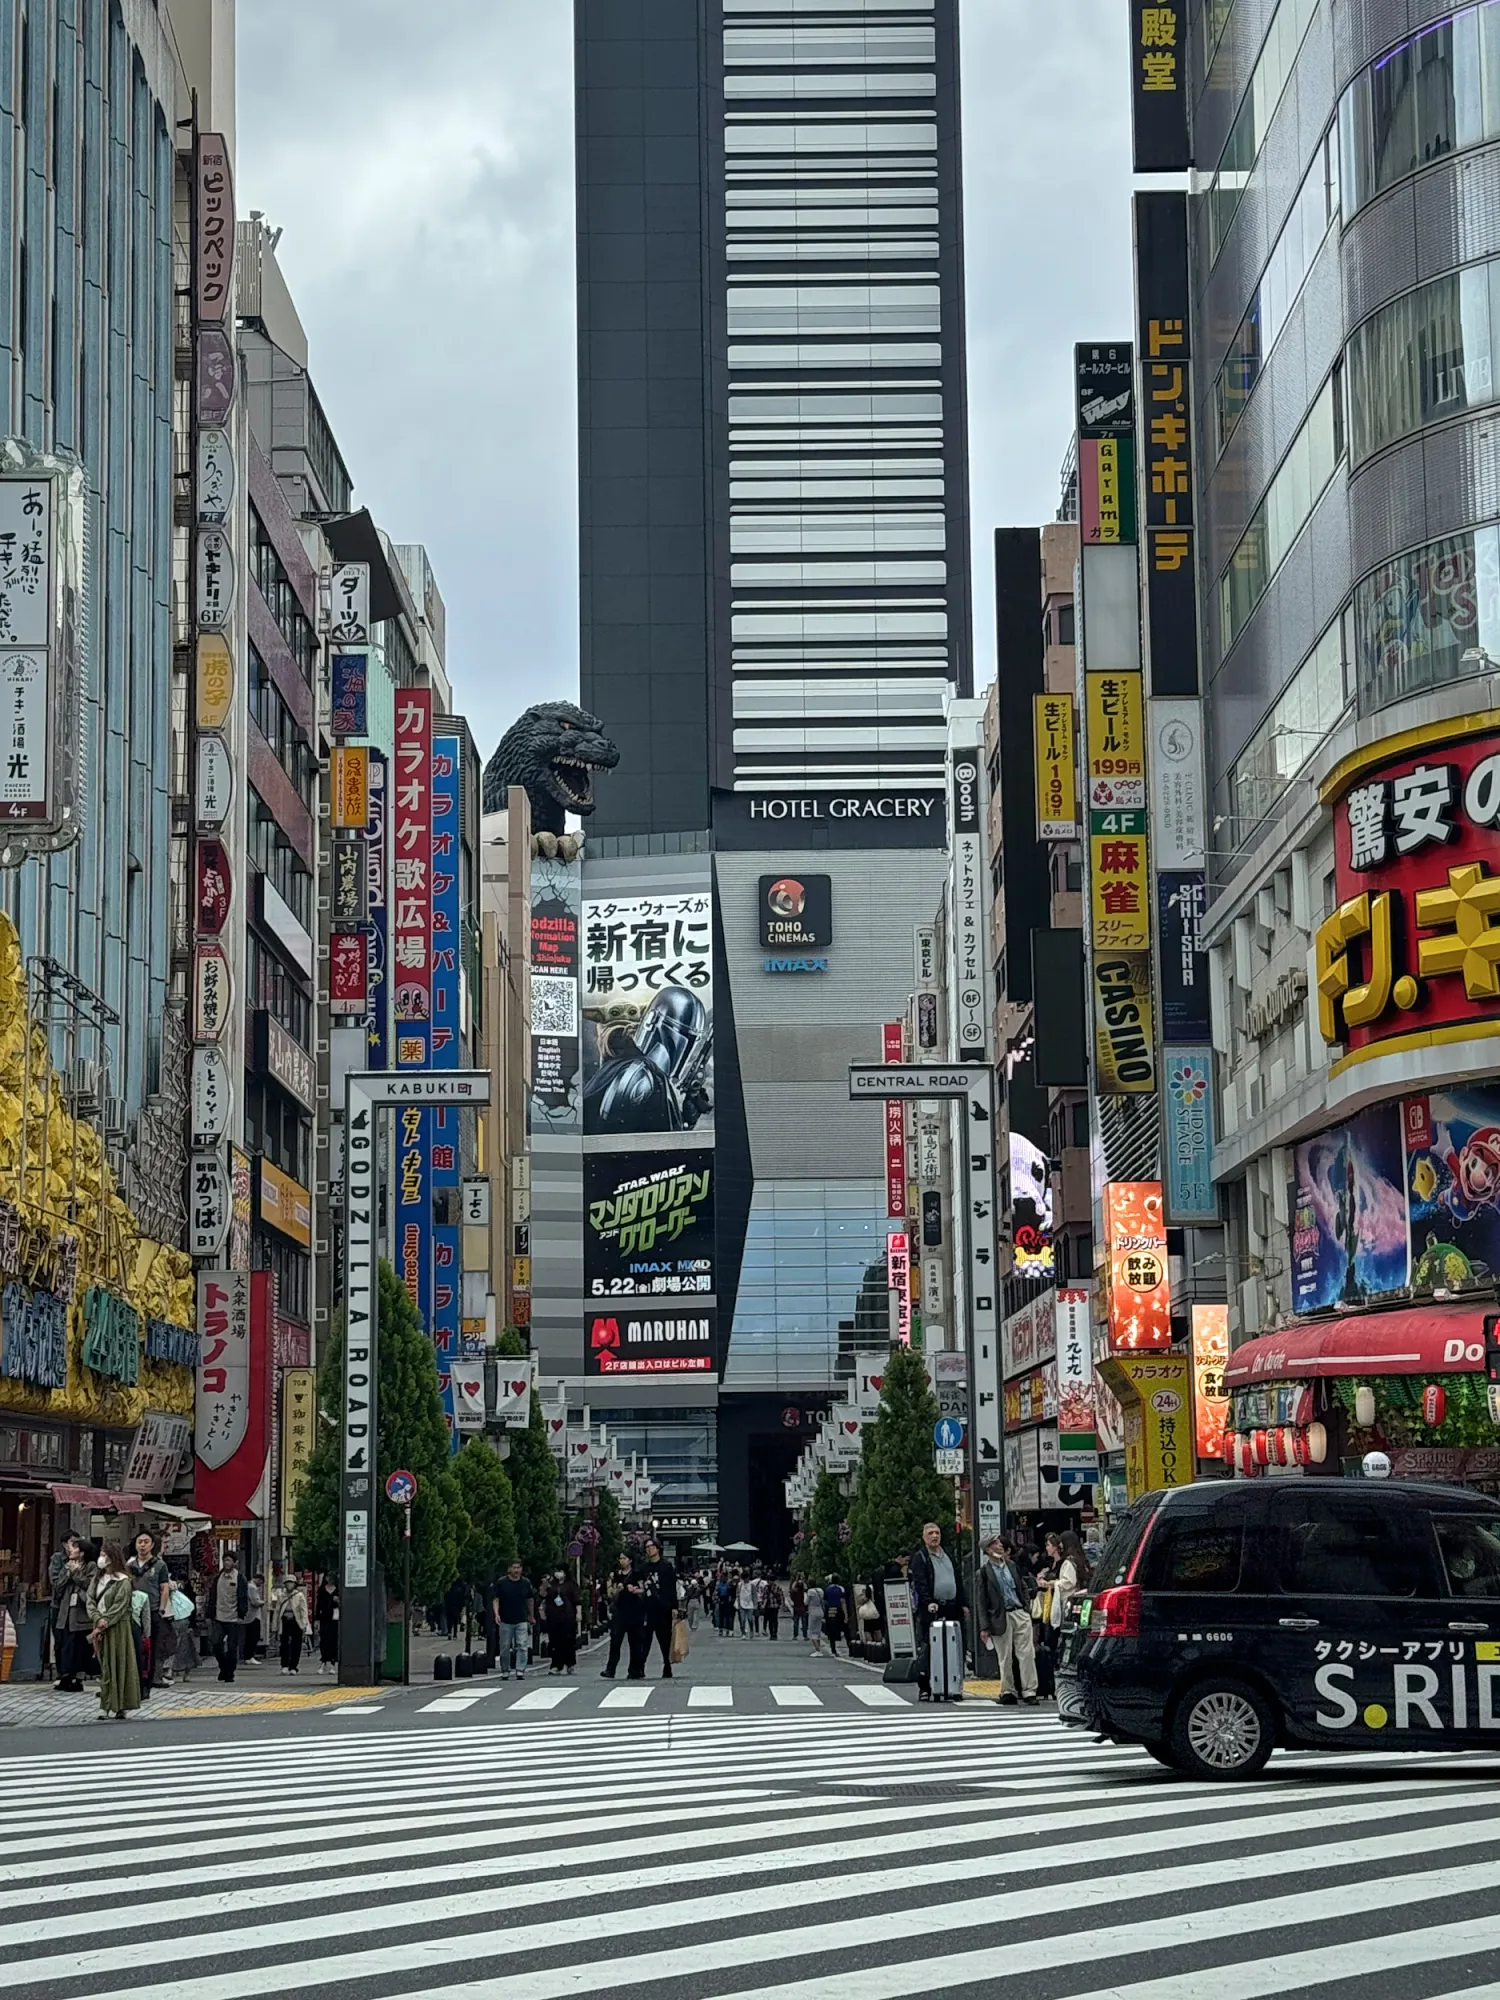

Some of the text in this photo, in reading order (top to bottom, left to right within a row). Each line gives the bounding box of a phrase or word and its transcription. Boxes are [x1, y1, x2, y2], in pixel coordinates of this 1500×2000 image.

[1141, 0, 1177, 91] 殿堂
[202, 154, 223, 167] 新宿
[1099, 444, 1118, 521] Garam
[204, 512, 219, 522] 7F
[340, 577, 360, 628] ダーツ
[200, 610, 223, 623] 6F
[203, 660, 229, 706] 虎の子
[12, 687, 25, 749] チキン酒場
[1100, 680, 1121, 752] 生ビール
[1044, 702, 1061, 761] 生ビール
[7, 753, 30, 779] 光
[1093, 759, 1141, 775] 199円
[346, 757, 362, 816] 鳥貴族
[1050, 764, 1062, 817] 199円
[8, 803, 28, 818] 4F
[203, 794, 217, 810] 光
[750, 797, 935, 819] HOTEL GRACERY
[396, 701, 427, 969] カラオケ歌広場
[1101, 814, 1135, 833] 4F
[338, 845, 359, 907] 山内農場
[1098, 840, 1140, 914] 麻雀
[586, 897, 710, 919] スター・ウォーズが
[961, 841, 977, 980] ネットカフェ & カプセル
[532, 917, 575, 931] odzilla
[767, 922, 802, 933] TOHO
[1097, 920, 1134, 932] スリー
[1180, 884, 1194, 986] SHISHA
[539, 941, 559, 953] Map
[586, 918, 710, 963] 新宿に
[767, 932, 816, 944] CINEMAS
[1096, 932, 1146, 946] ファイブ
[550, 965, 569, 975] HERE
[586, 960, 711, 994] 帰ってくる
[763, 958, 828, 973] IMAX
[203, 959, 218, 1030] お好み焼き
[339, 1000, 357, 1013] 4F
[1095, 959, 1153, 1082] CASINO
[402, 1040, 422, 1061] 薬
[856, 1075, 968, 1087] CENTRAL ROAD
[203, 1068, 218, 1130] とらそば
[198, 1134, 216, 1145] 1F
[1177, 1108, 1192, 1166] STAGE
[1191, 1108, 1205, 1156] IDOL
[613, 1164, 687, 1195] STAR WARS
[1180, 1182, 1205, 1200] 5F
[195, 1173, 218, 1229] かっぱ
[588, 1168, 711, 1231] マンダロリアン
[196, 1236, 215, 1247] B1
[402, 1223, 420, 1258] Shop
[599, 1228, 619, 1240] アンド
[618, 1205, 697, 1259] グローグー
[1115, 1236, 1168, 1250] ドリンクバー
[629, 1262, 673, 1273] IMAX
[1127, 1257, 1156, 1271] 飲み
[348, 1136, 370, 1438] GODZILLA ROAD
[970, 1153, 995, 1407] ゴジラロード
[1128, 1272, 1156, 1286] 放題
[230, 1275, 246, 1339] 大衆酒場
[203, 1282, 229, 1393] トラノコ
[627, 1319, 710, 1343] MARUHAN
[1065, 1342, 1082, 1376] 九十九
[1131, 1365, 1185, 1379] カラオケ
[456, 1382, 464, 1399] I
[503, 1380, 511, 1398] I
[203, 1403, 225, 1451] やきとん
[221, 1393, 243, 1441] やきとり
[1061, 1455, 1096, 1463] FamilyMart
[1205, 1632, 1233, 1642] 6606
[1313, 1640, 1466, 1661] タクシーアプリ
